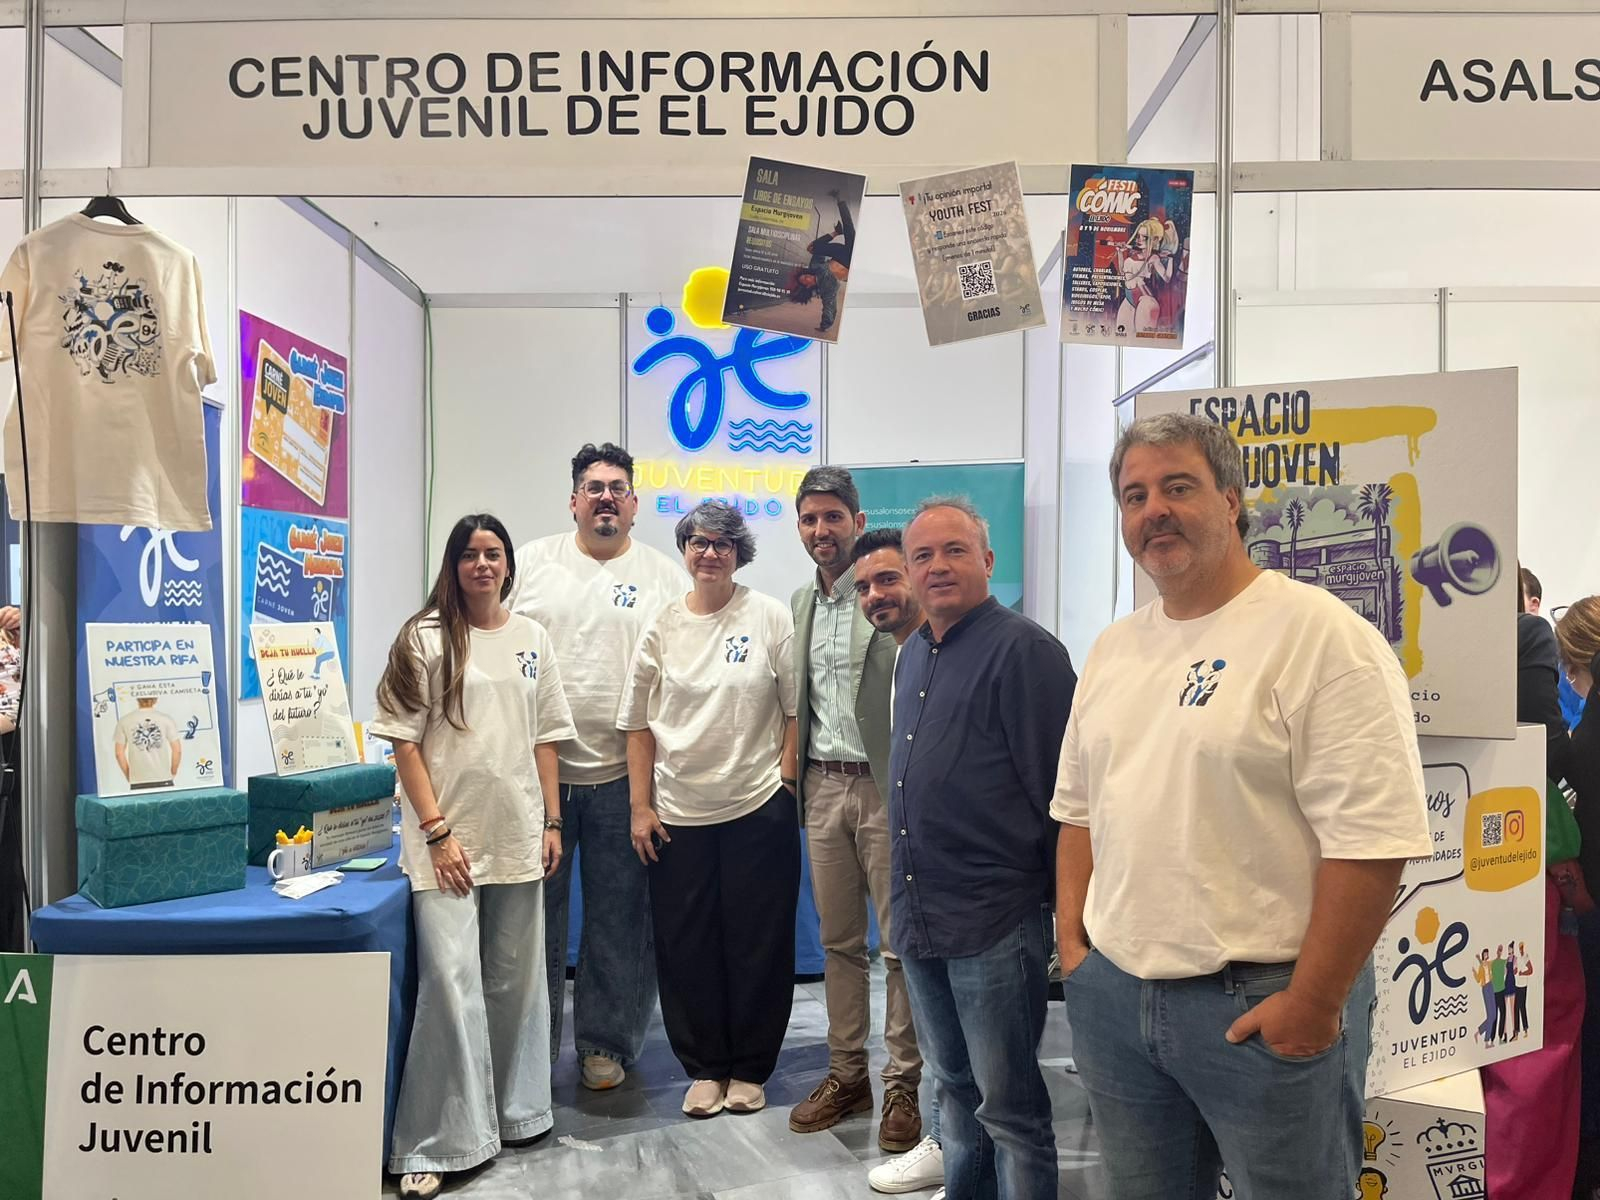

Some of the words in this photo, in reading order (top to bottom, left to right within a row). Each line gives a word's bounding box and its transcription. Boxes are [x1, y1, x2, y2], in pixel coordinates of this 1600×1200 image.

[229, 52, 467, 99] CENTRO
[487, 51, 562, 93] DE
[581, 39, 989, 93] INFORMACIÓN
[1420, 58, 1600, 104] ASALS
[302, 95, 549, 140] JUVENIL
[566, 94, 641, 136] DE
[659, 94, 727, 137] EL
[745, 94, 915, 137] EJIDO
[756, 168, 779, 186] SALA
[1107, 179, 1137, 192] FESTI
[752, 188, 772, 203] LIBRE
[773, 191, 782, 204] DE
[935, 189, 961, 202] opinión
[1080, 181, 1141, 215] CÓMIC
[751, 204, 772, 215] Espacio
[929, 205, 965, 222] YOUTH
[968, 200, 992, 215] FEST
[753, 265, 780, 275] GRATUITO
[967, 307, 1001, 322] GRACIAS
[264, 363, 284, 386] CARNÉ
[263, 379, 288, 408] JOVEN
[1243, 441, 1340, 489] IJOVEN
[633, 463, 806, 496] JUVENTUD
[656, 495, 686, 514] EL
[702, 497, 783, 517] IDO
[1330, 563, 1366, 573] espacio
[1326, 570, 1385, 585] murgijoven
[277, 603, 295, 616] JOVEN
[106, 640, 172, 653] PARTICIPA
[176, 639, 194, 651] EN
[260, 648, 279, 658] DEJA
[280, 649, 289, 657] TU
[291, 647, 317, 657] HUELLA
[105, 654, 166, 668] NUESTRA
[171, 654, 199, 666] RIFA
[170, 687, 201, 696] CAMISETA
[268, 688, 293, 702] dirías
[1411, 690, 1441, 701] cio
[272, 708, 286, 721] del
[1414, 711, 1431, 723] do
[1434, 831, 1445, 842] DE
[1470, 849, 1537, 871] @juventudelejido
[83, 1025, 206, 1057] Centro
[1391, 1026, 1468, 1056] JUVENTUD
[1403, 1057, 1417, 1069] EL
[1422, 1046, 1456, 1064] EJIDO
[80, 1071, 124, 1104] de
[136, 1066, 362, 1105] Información
[78, 1121, 212, 1154] Juvenil
